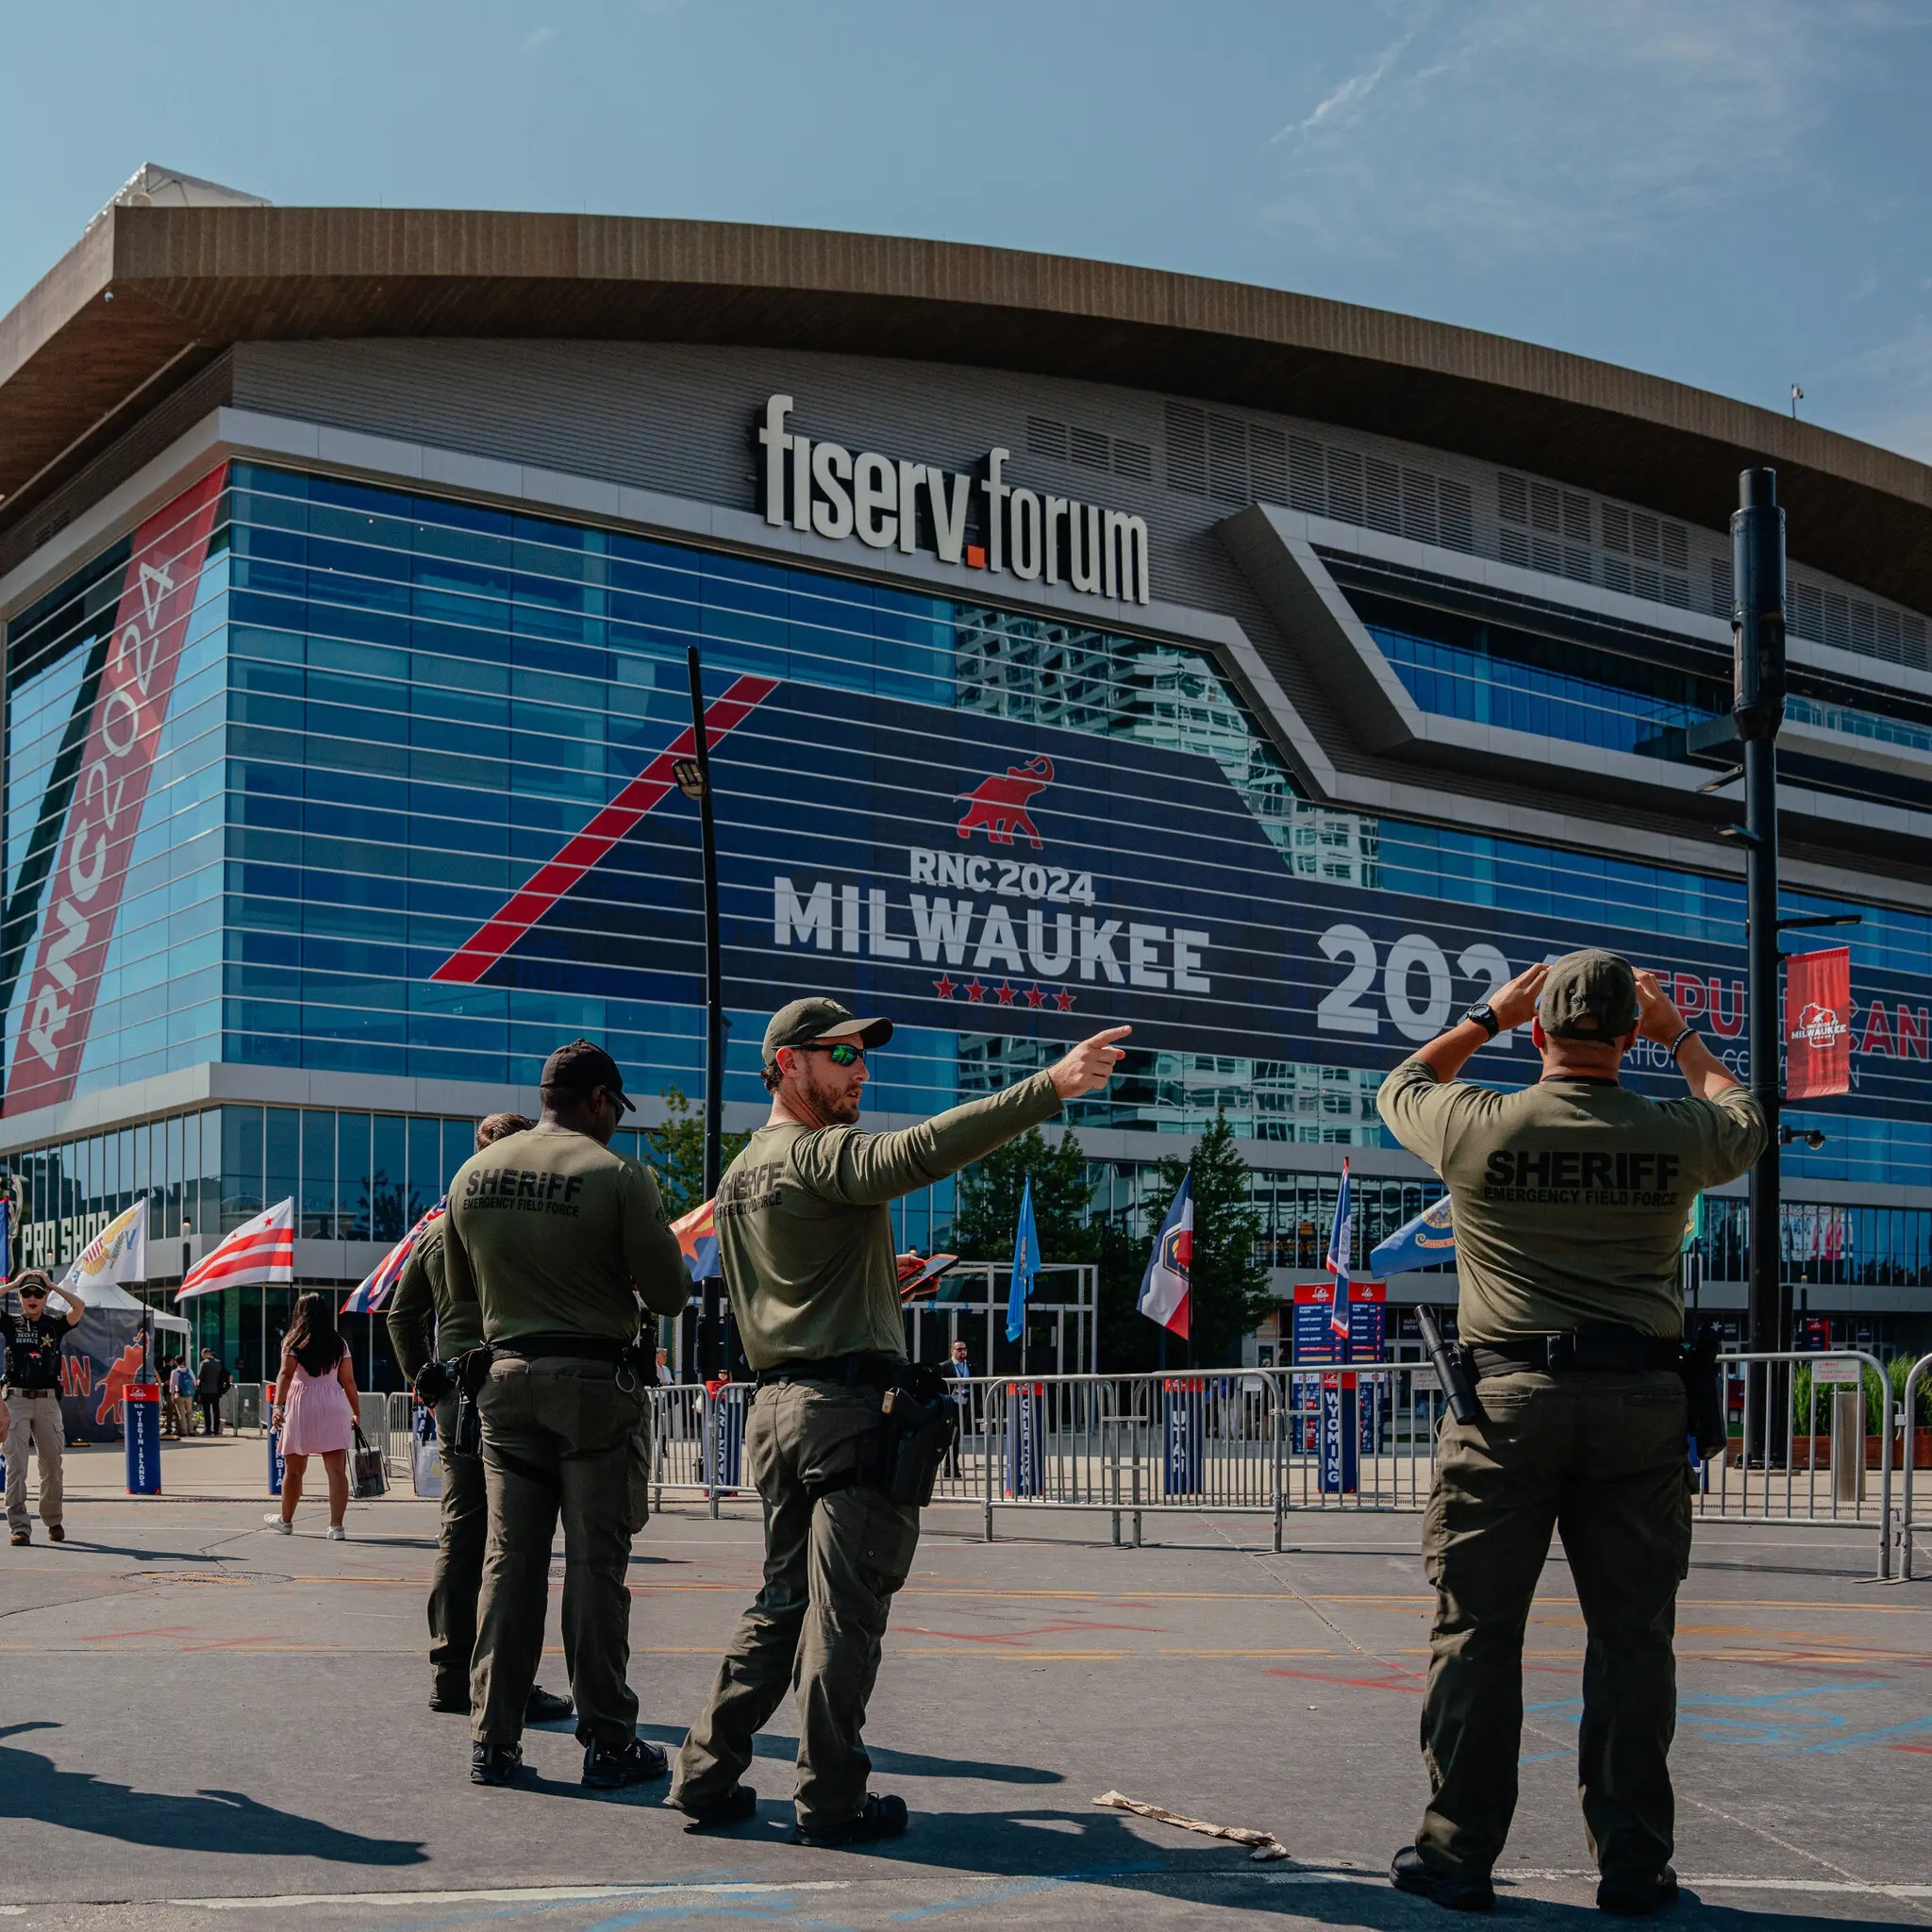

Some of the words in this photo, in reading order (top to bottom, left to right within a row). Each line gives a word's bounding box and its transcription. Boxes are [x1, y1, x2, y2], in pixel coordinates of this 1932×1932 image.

[774, 876, 1210, 993] MILWAUKEE
[1791, 1024, 1847, 1040] MILWAUKEE
[466, 1168, 584, 1203] SHERIFF
[1485, 1150, 1678, 1191] SHERIFF
[463, 1195, 515, 1211] EMERGENCY
[517, 1199, 543, 1212] FIELD
[545, 1201, 579, 1218] FORCE
[1484, 1186, 1580, 1204] EMERGENCY
[1586, 1191, 1627, 1205] FIELD
[1633, 1192, 1678, 1206] FORCE
[23, 1220, 57, 1269] PRO
[1173, 1410, 1187, 1473] UTAH
[1325, 1391, 1341, 1484] WYOMING
